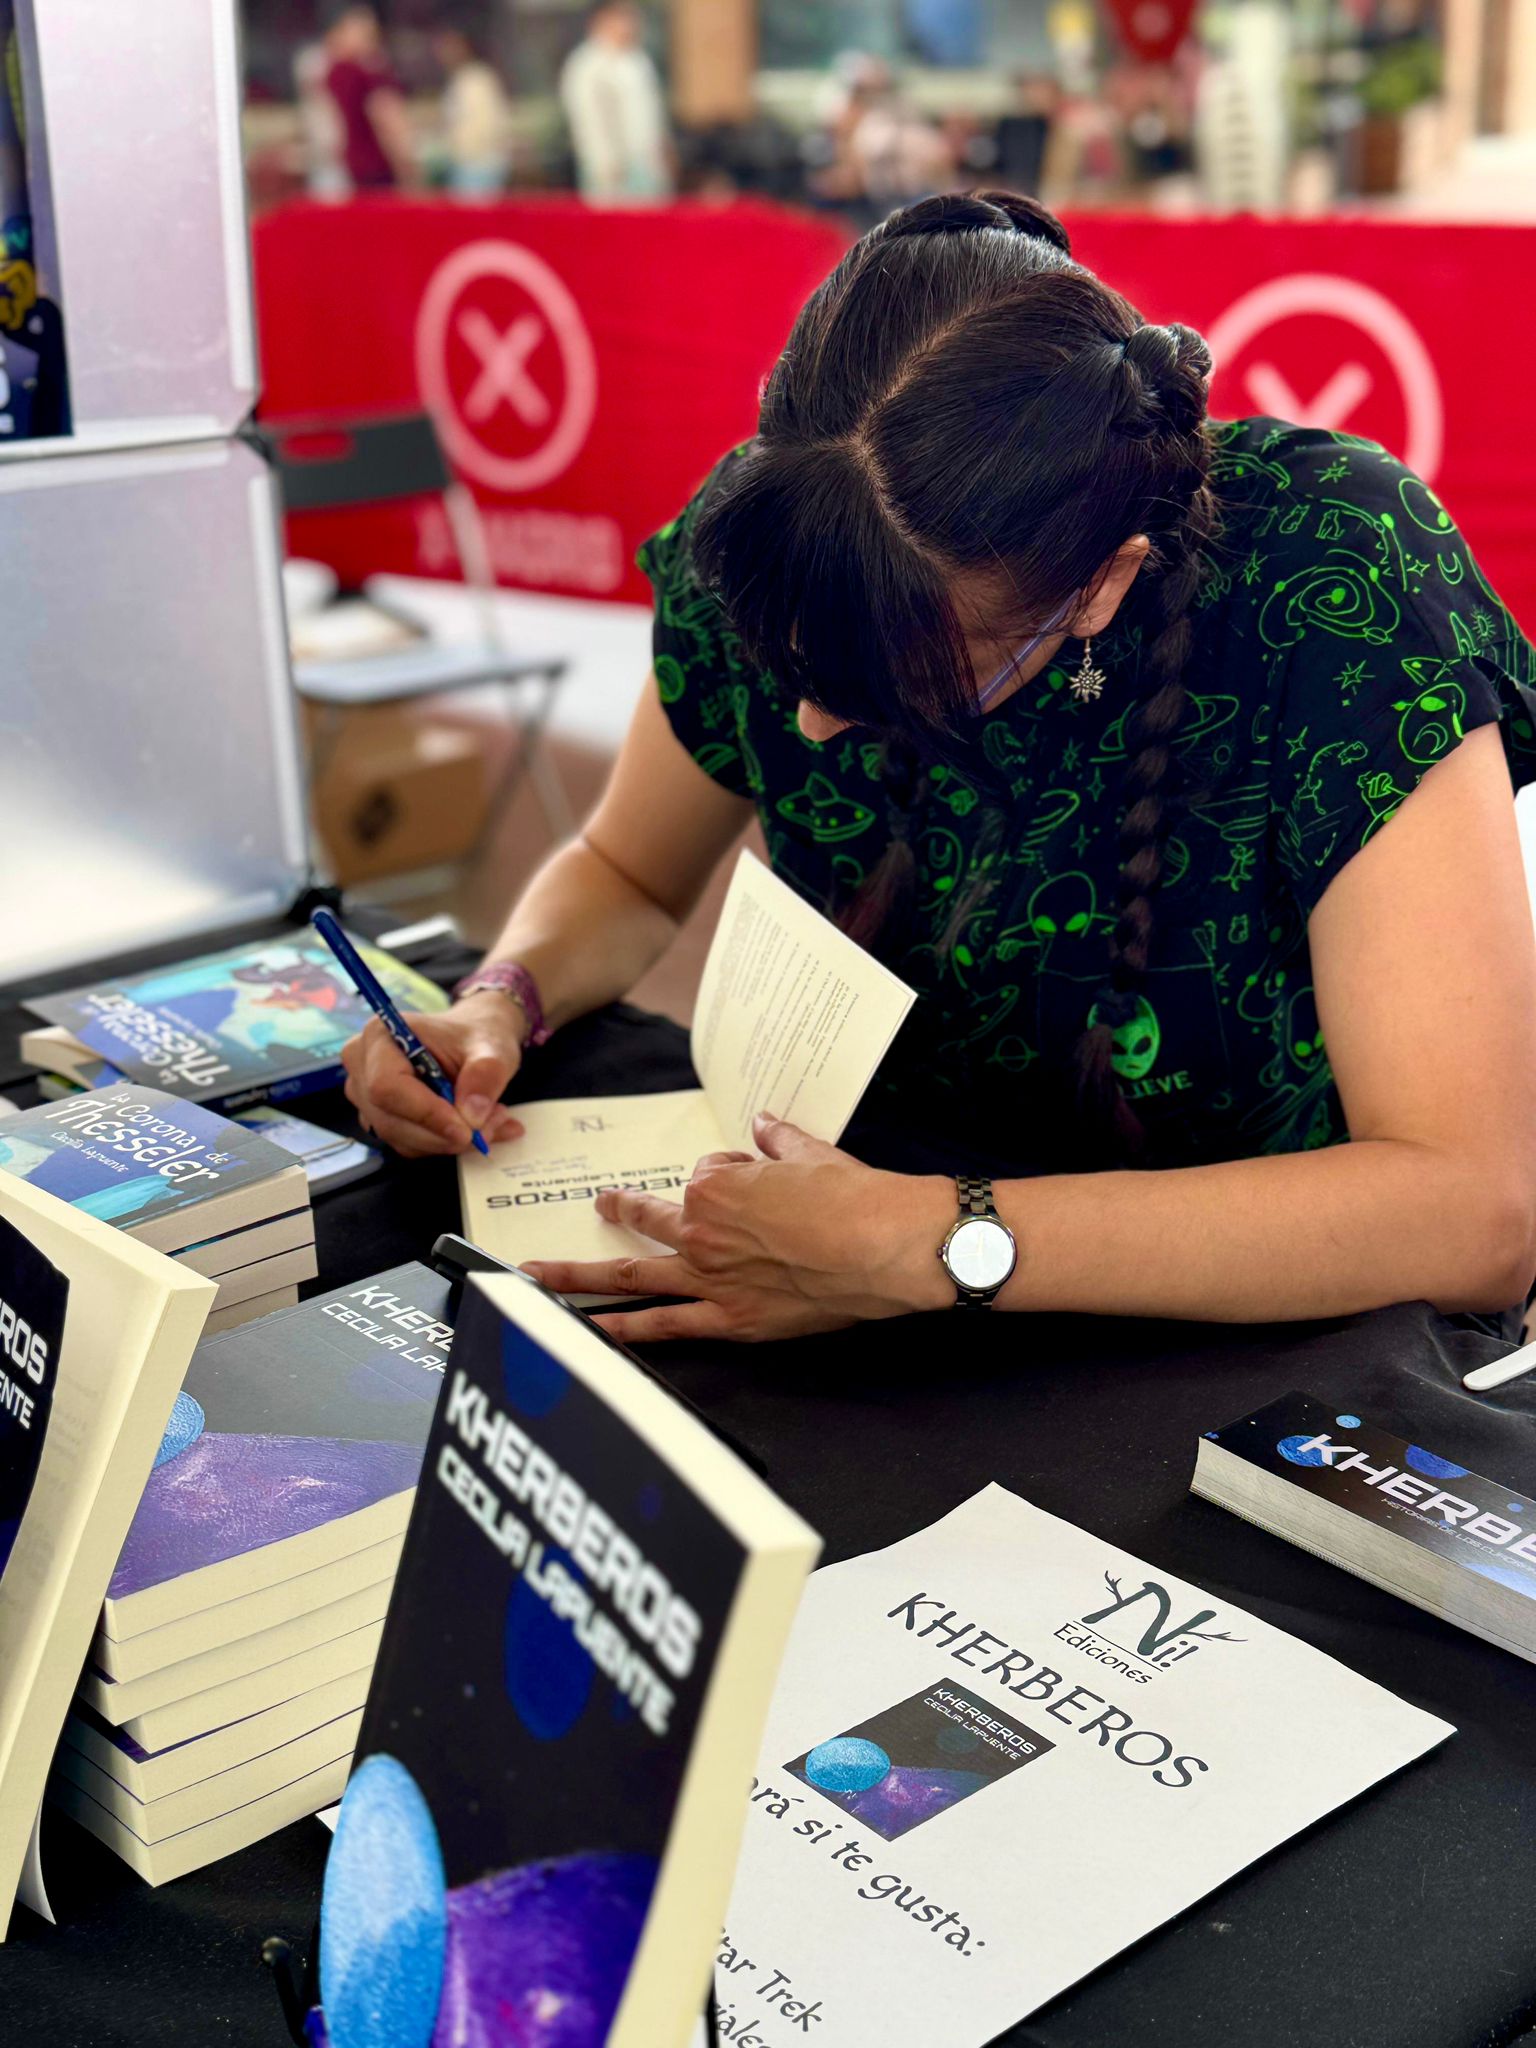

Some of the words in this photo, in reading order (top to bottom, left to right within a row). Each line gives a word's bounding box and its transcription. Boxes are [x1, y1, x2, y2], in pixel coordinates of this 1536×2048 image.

[45, 1099, 220, 1183] Thesseler
[116, 1104, 198, 1148] Corona
[206, 1152, 229, 1164] de
[521, 1172, 615, 1188] Lapuente
[620, 1164, 684, 1178] Cecilia
[0, 1299, 48, 1385] ROS
[321, 1303, 409, 1350] CECILIA
[446, 1369, 702, 1680] KHERBEROS
[523, 1541, 677, 1736] LAPUENTE
[1053, 1622, 1152, 1684] Ediciones
[887, 1592, 1209, 1787] KHERBEROS
[933, 1688, 1037, 1754] KHERBEROS
[923, 1697, 963, 1723] CECILIA
[962, 1721, 1021, 1760] LAPUENTE
[793, 1819, 843, 1844] si
[831, 1841, 873, 1872] te
[857, 1875, 985, 1956] gusta:
[756, 1969, 823, 2032] Trek
